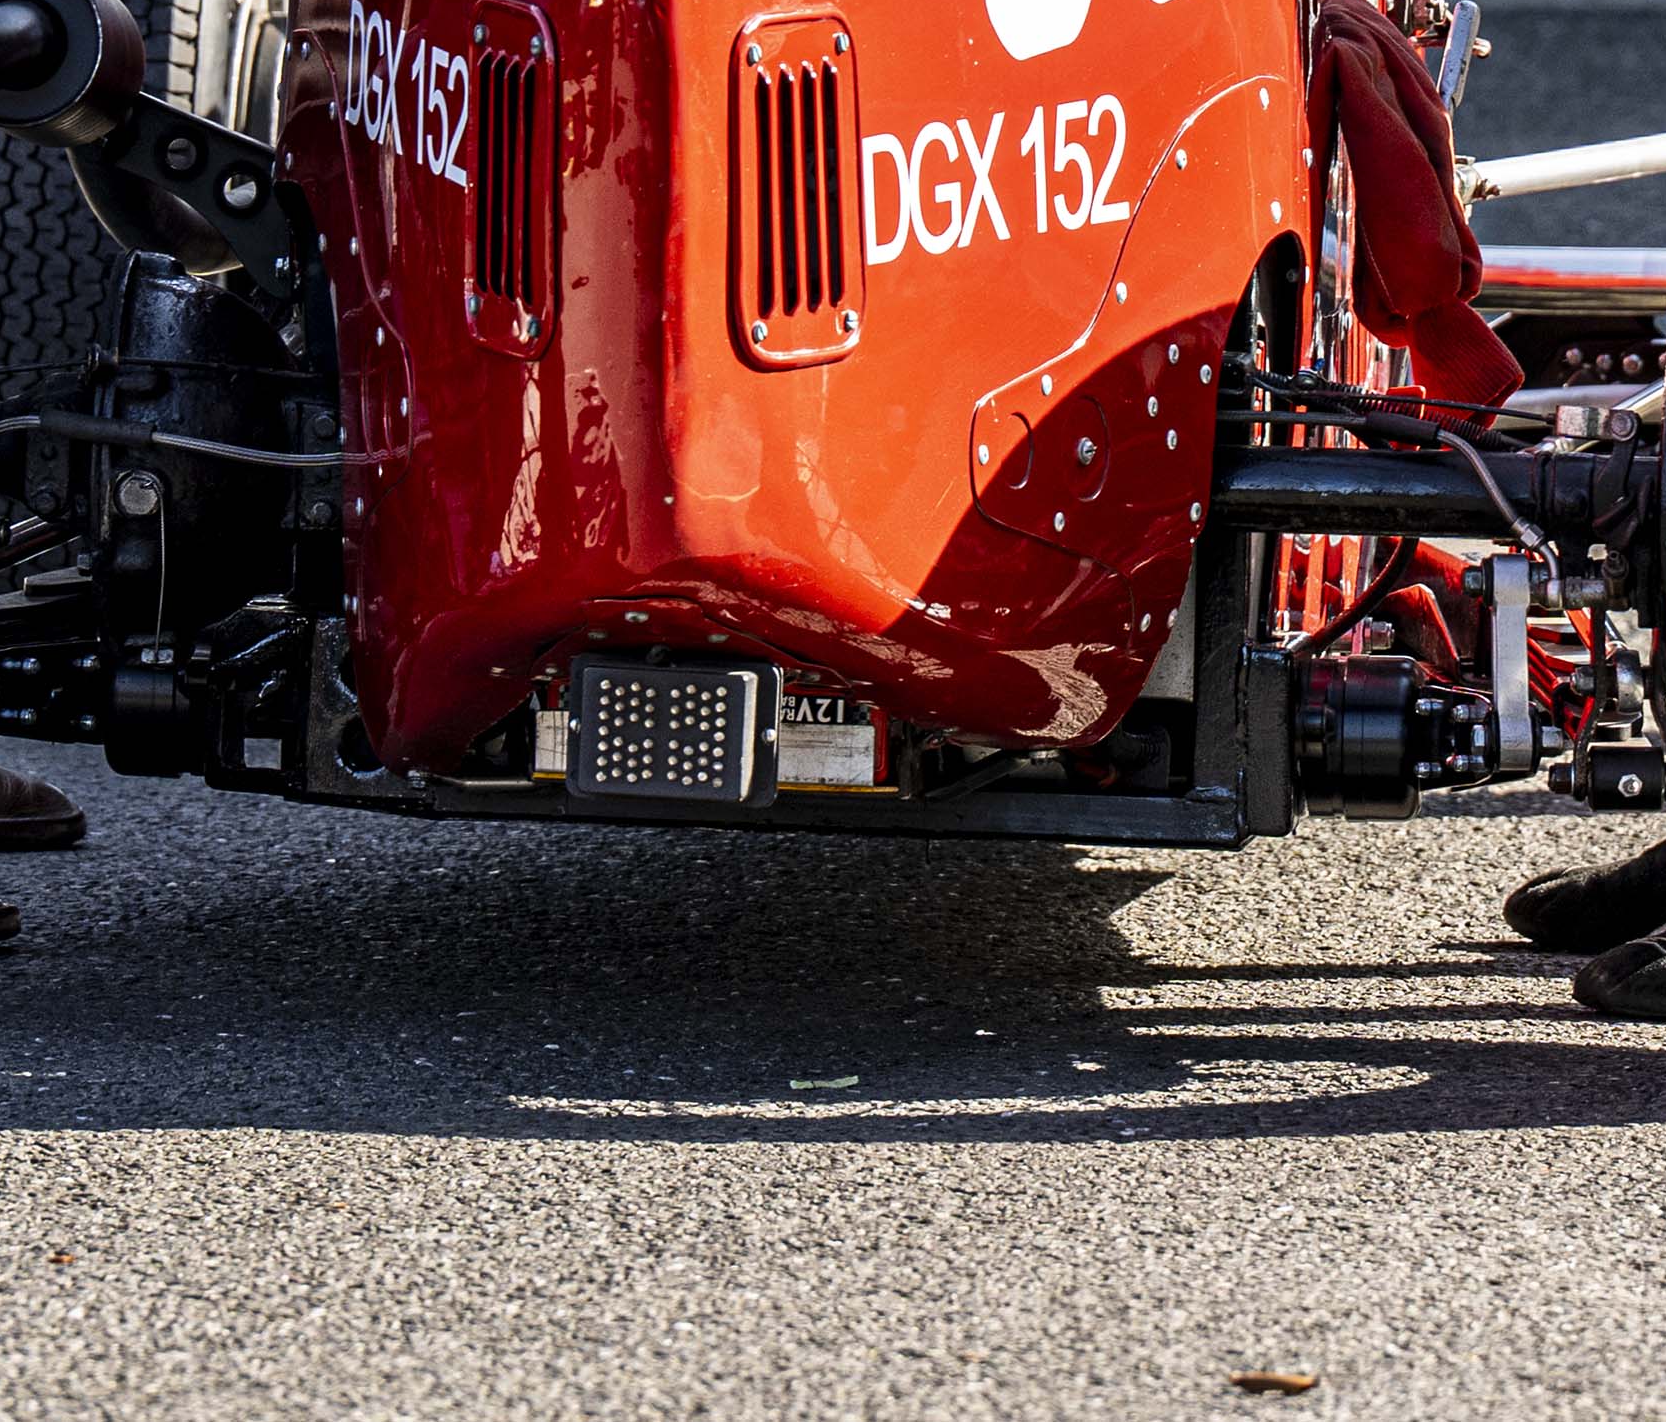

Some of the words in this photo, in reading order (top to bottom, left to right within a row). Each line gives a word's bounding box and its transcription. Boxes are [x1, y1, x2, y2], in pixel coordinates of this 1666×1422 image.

[411, 38, 469, 187] 152
[861, 112, 1011, 266] DGX
[1020, 94, 1130, 234] 152
[795, 698, 845, 723] 12V
